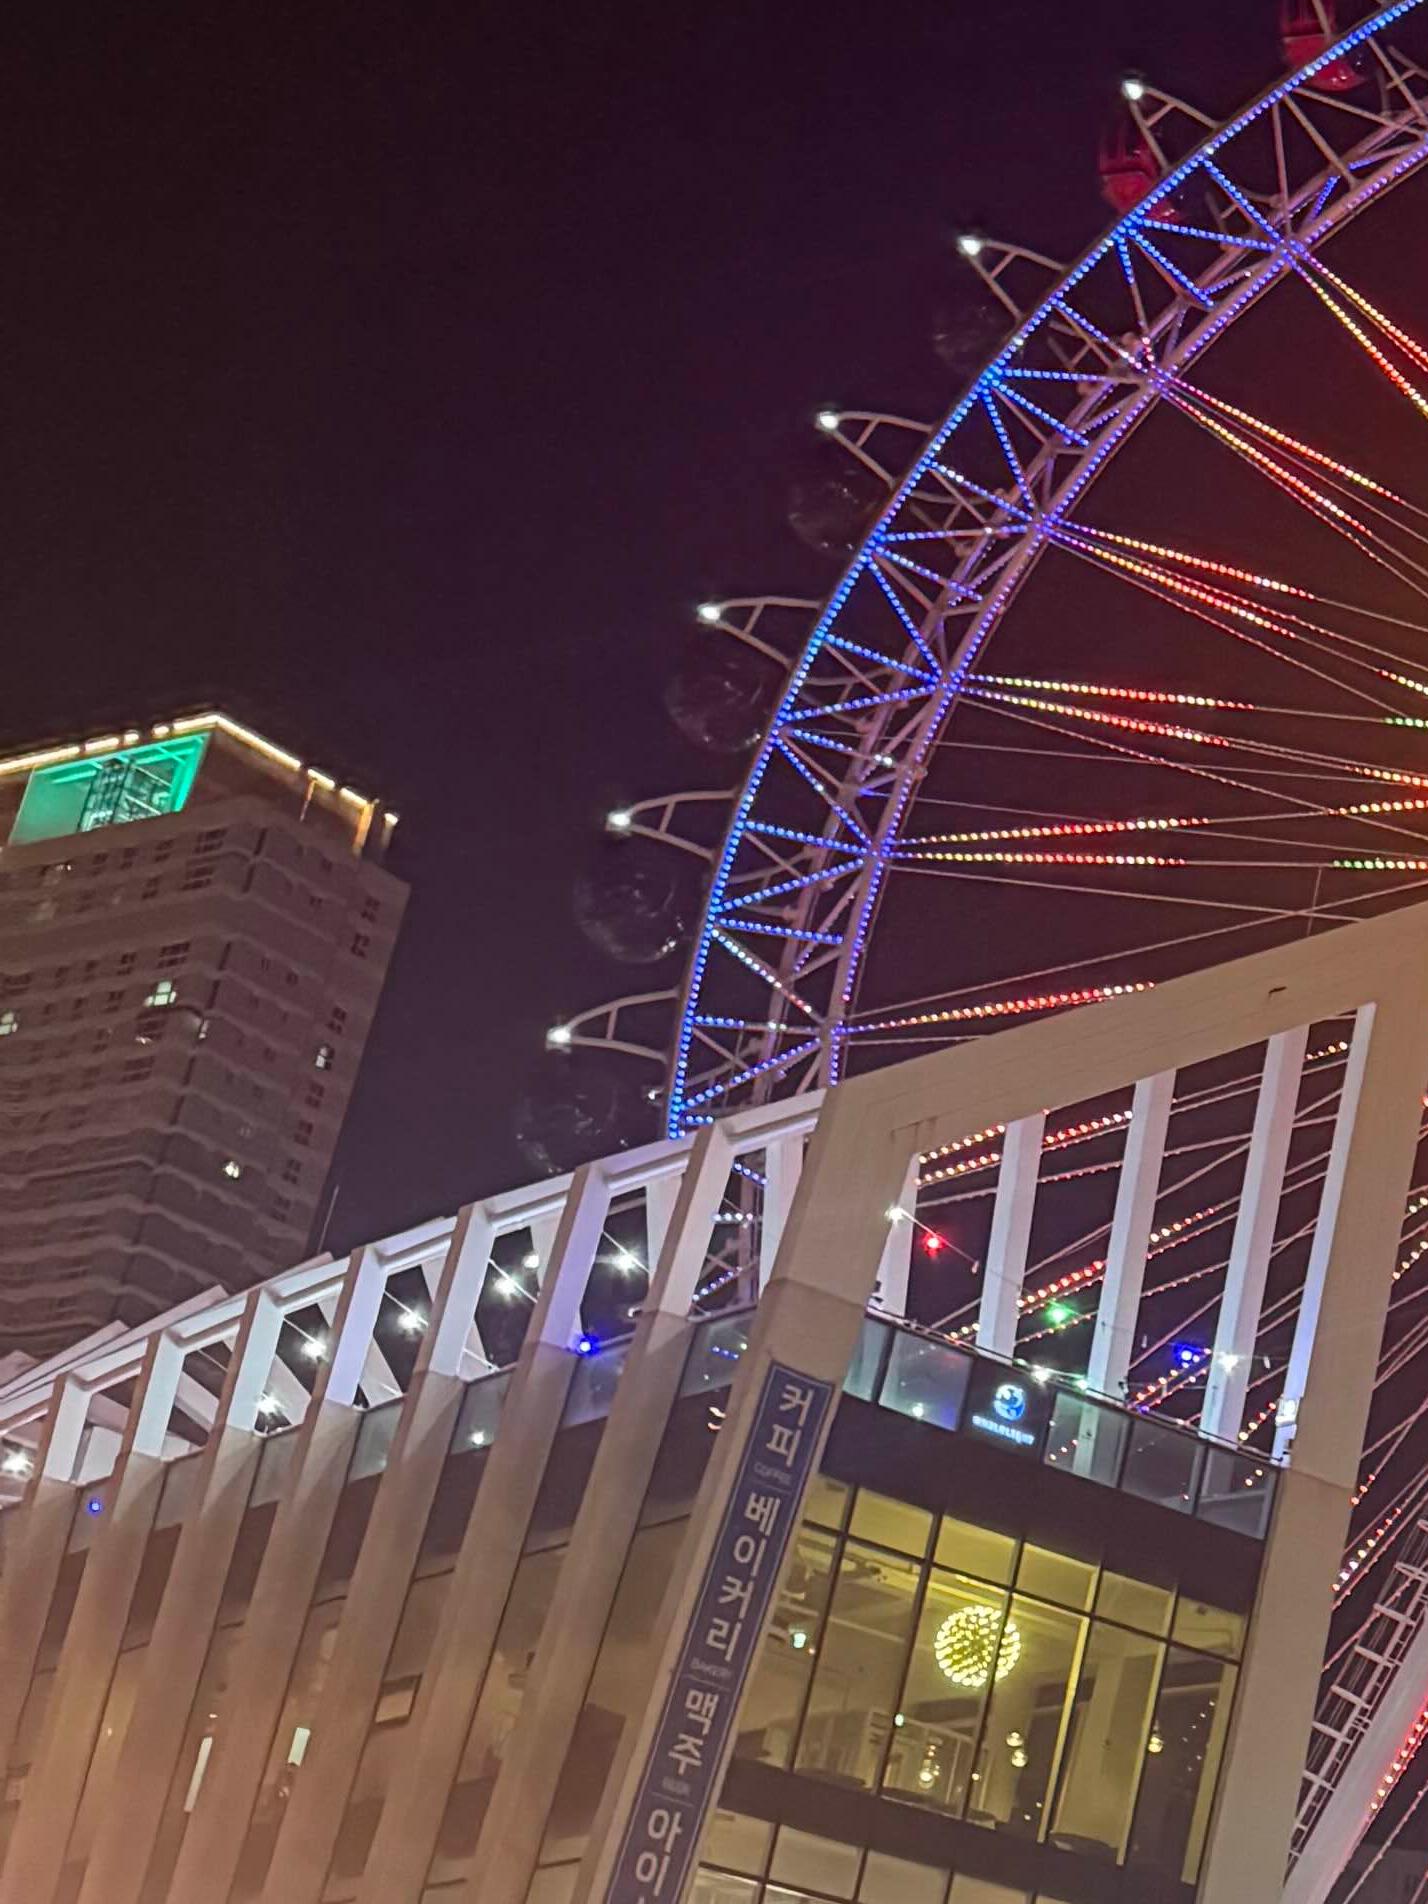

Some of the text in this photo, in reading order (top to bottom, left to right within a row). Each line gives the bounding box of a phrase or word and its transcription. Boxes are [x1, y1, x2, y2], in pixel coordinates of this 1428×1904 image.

[766, 1384, 814, 1467] 커피
[706, 1492, 780, 1662] 베이커리
[668, 1689, 720, 1775] 맥주
